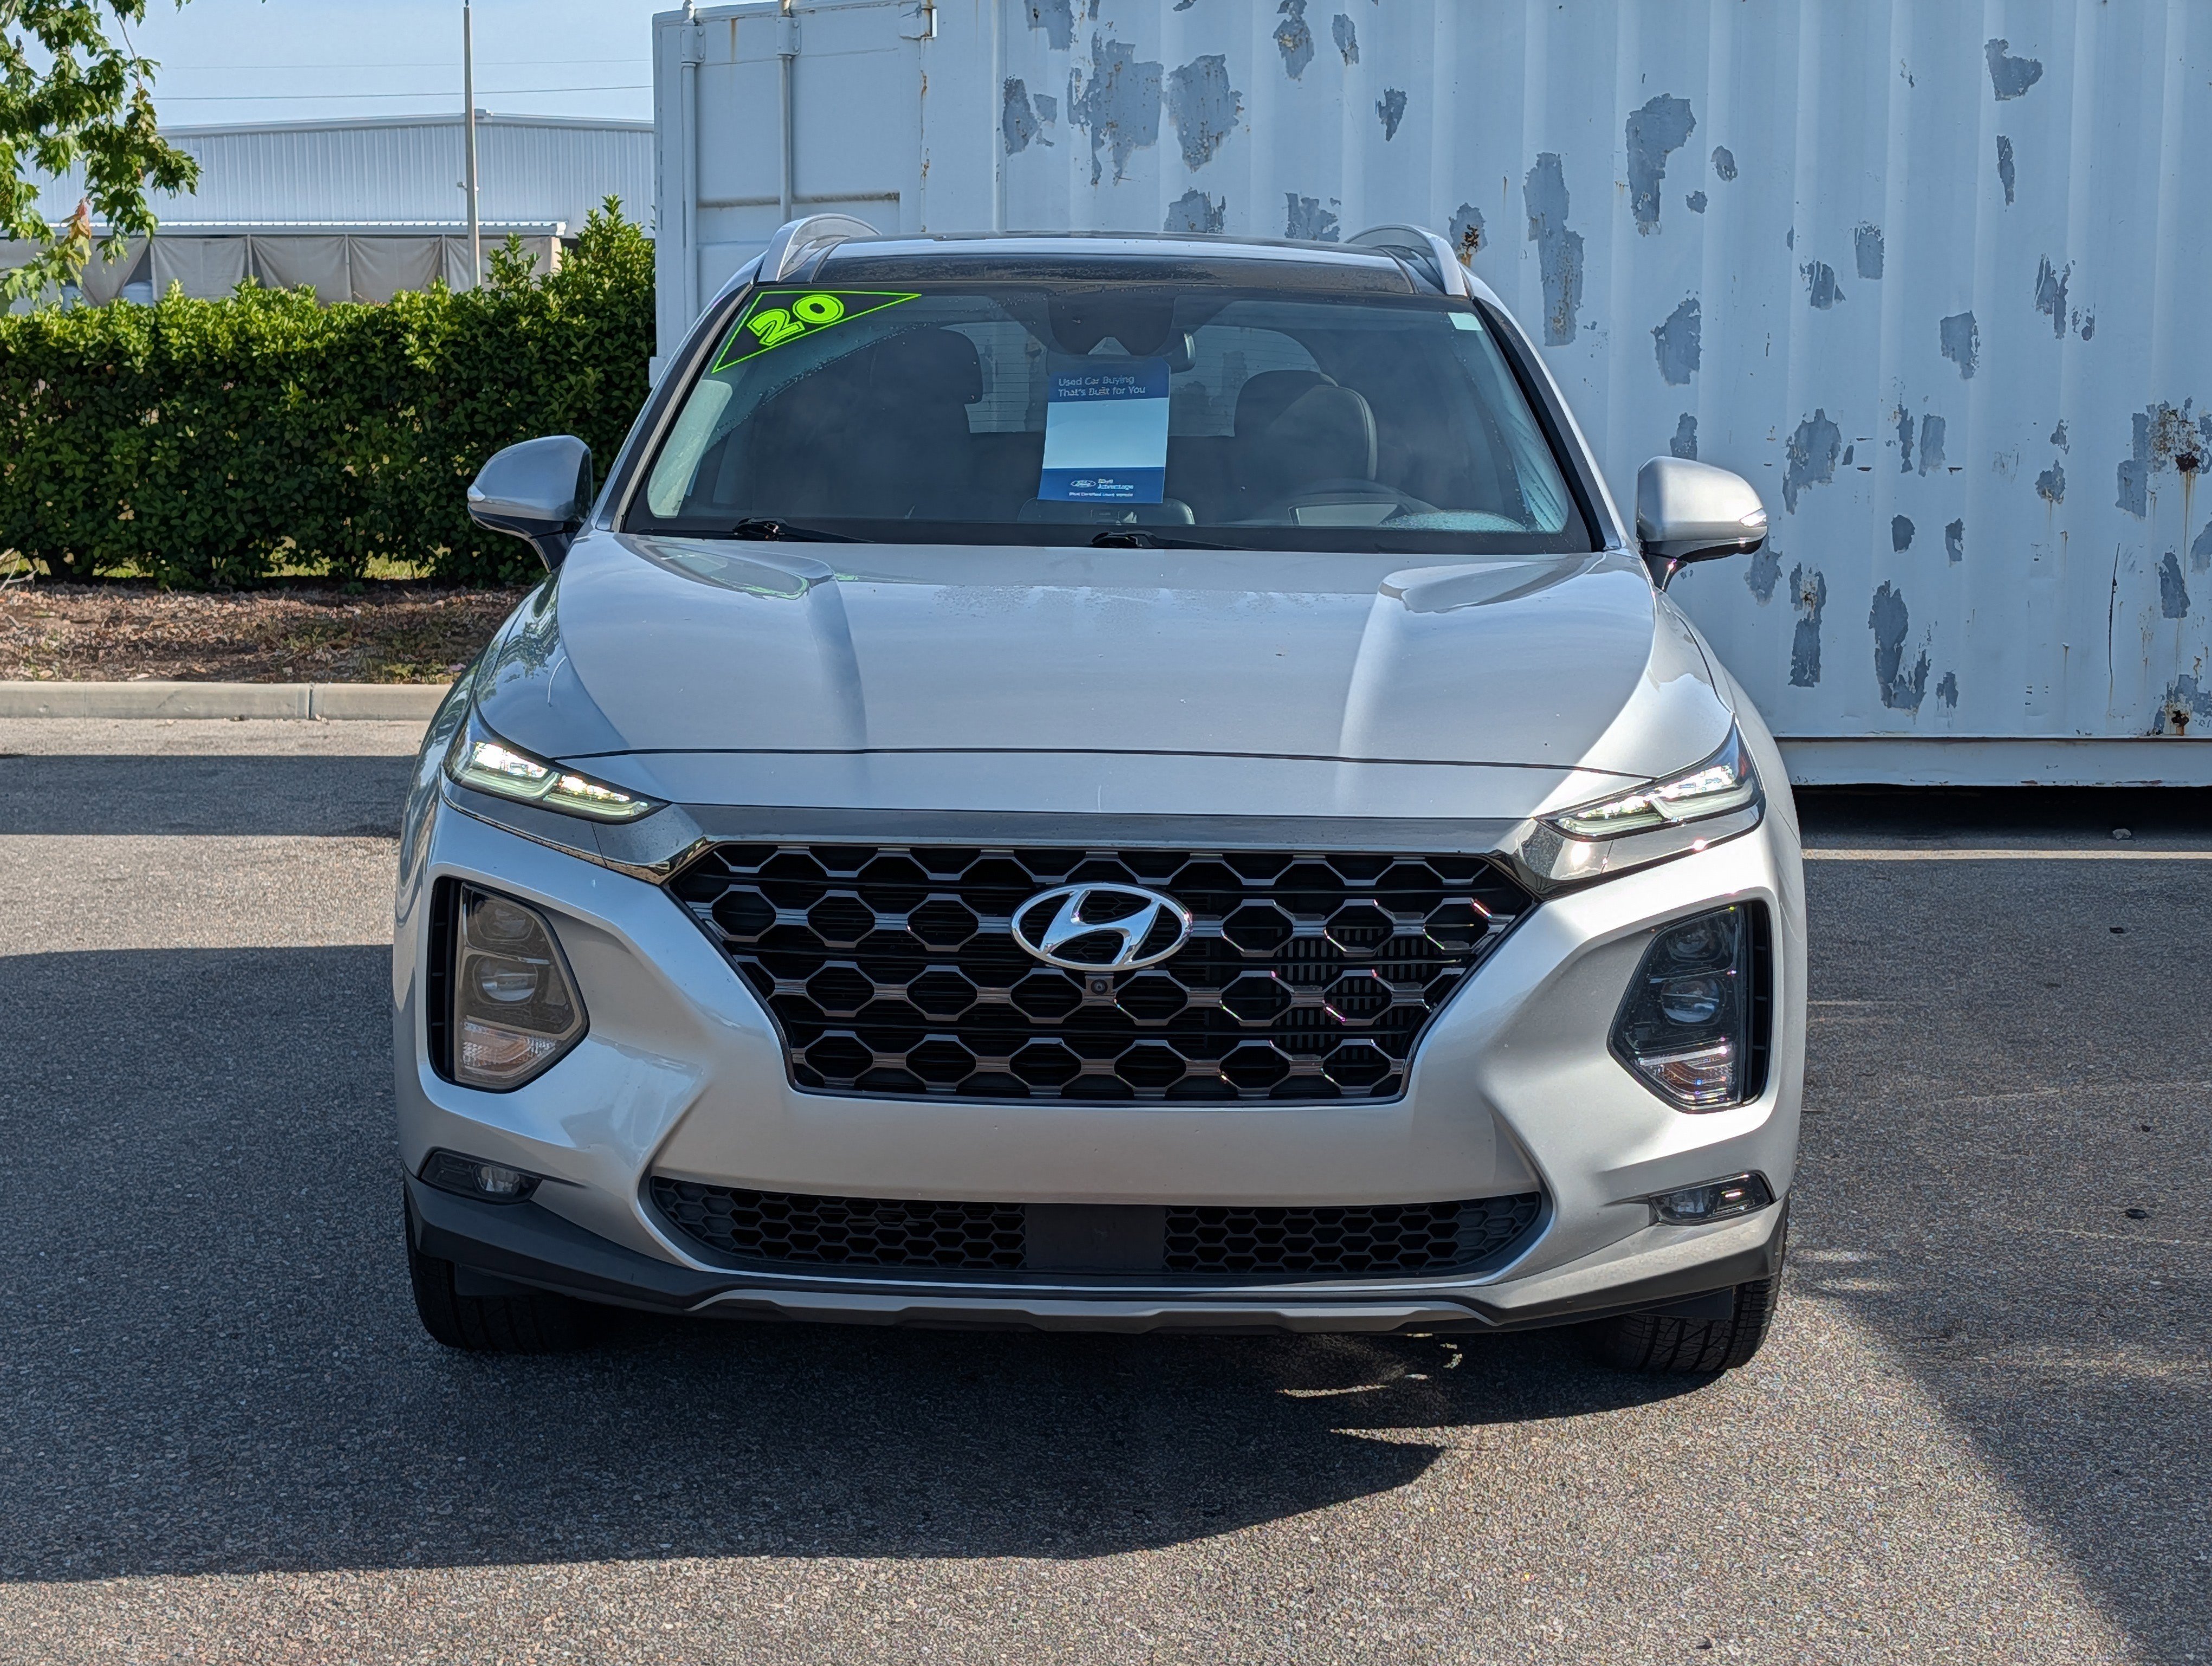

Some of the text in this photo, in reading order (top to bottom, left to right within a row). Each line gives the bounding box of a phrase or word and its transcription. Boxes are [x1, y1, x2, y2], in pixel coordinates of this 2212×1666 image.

[747, 294, 844, 346] 20
[1058, 375, 1134, 386] Used Car Buying
[1058, 388, 1086, 397] That's
[1113, 386, 1126, 395] for
[1128, 386, 1146, 394] You
